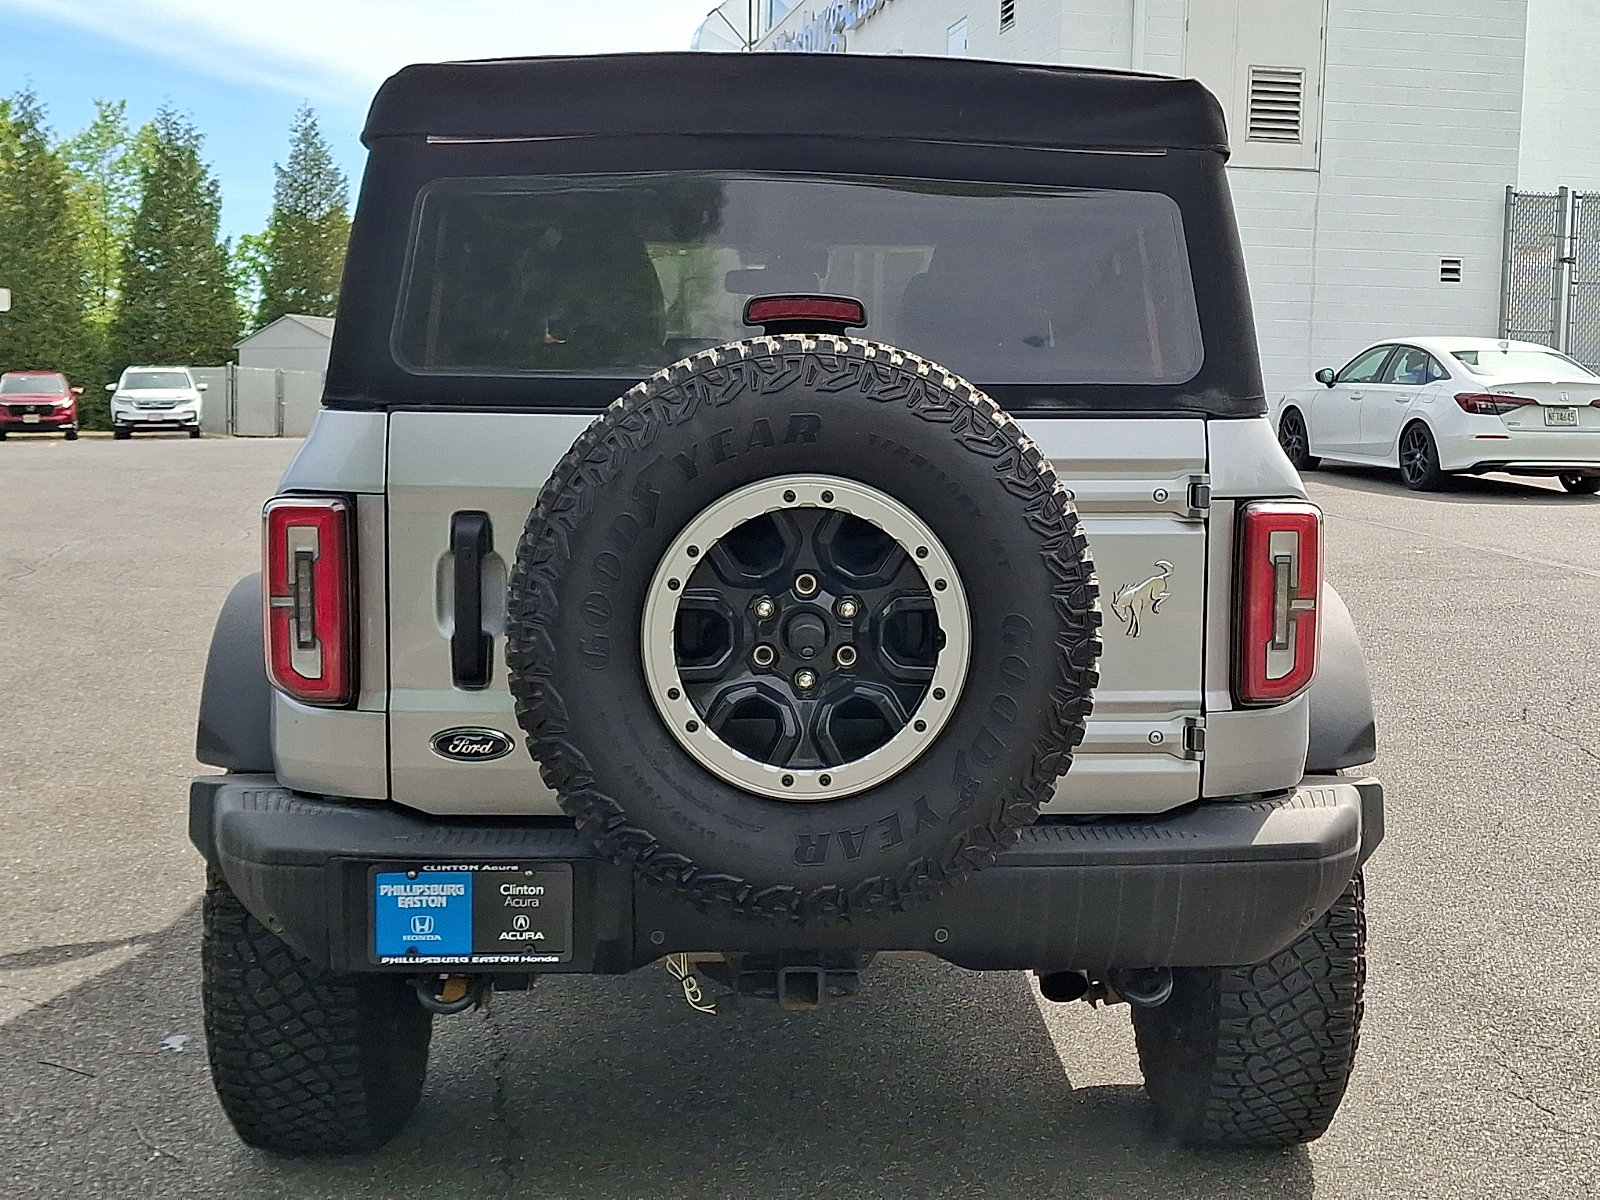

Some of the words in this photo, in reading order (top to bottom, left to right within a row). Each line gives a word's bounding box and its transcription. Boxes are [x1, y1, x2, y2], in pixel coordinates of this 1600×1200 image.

[448, 735, 494, 754] Ford
[379, 884, 465, 897] PHILLIPSBURG
[499, 884, 544, 895] Clinton
[397, 896, 447, 908] EASTON
[504, 896, 539, 907] Acura
[499, 931, 545, 940] ACURA
[380, 956, 469, 964] PHILLIPSBURG
